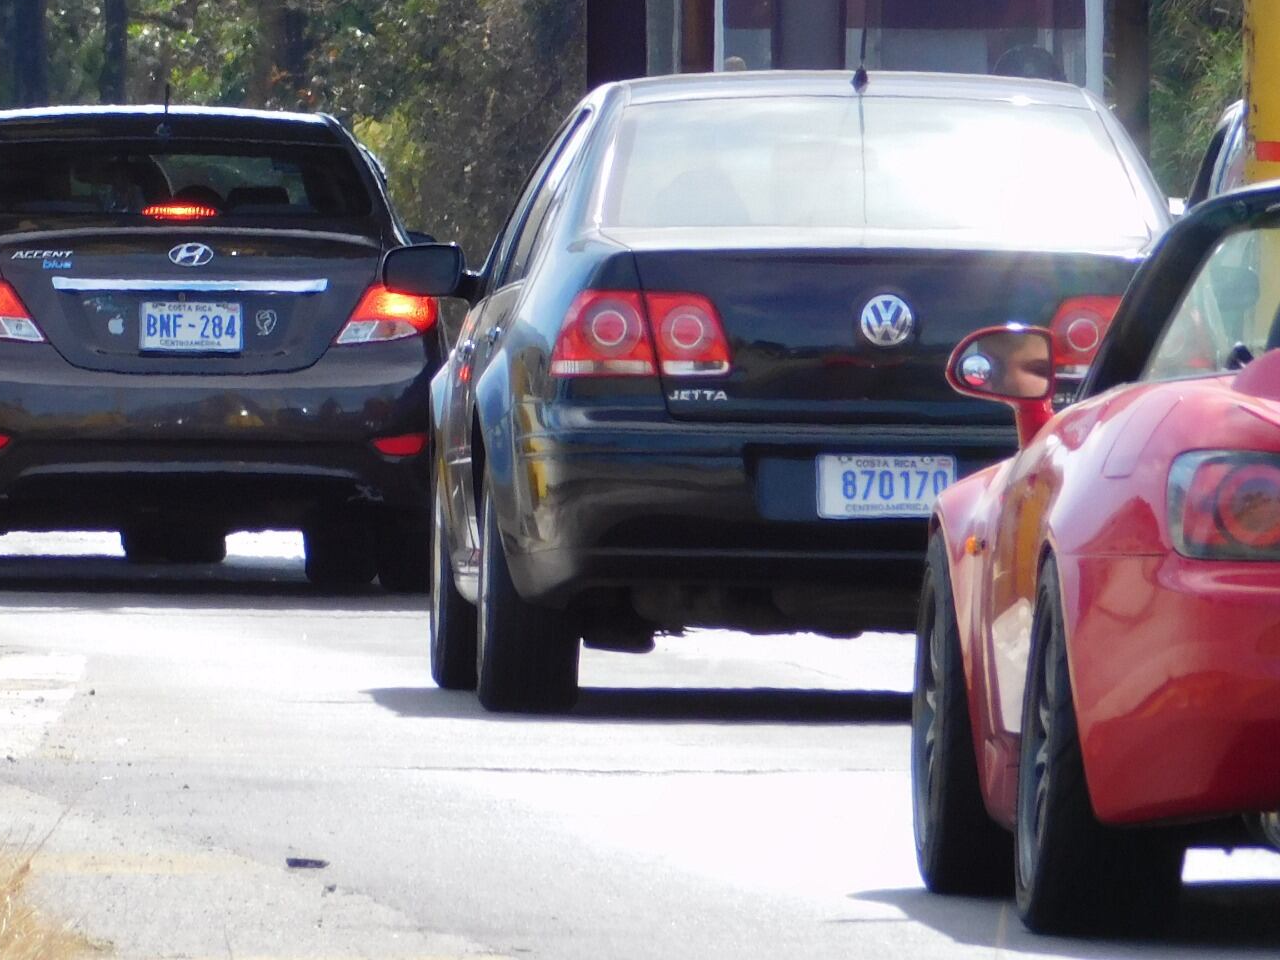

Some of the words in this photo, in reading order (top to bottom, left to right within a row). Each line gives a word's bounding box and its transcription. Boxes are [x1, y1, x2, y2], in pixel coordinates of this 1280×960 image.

[11, 250, 73, 259] ACCENT
[146, 314, 236, 338] BNF-284
[668, 390, 728, 400] JETTA
[856, 460, 889, 468] COSTA
[894, 459, 917, 468] RICA
[842, 470, 948, 499] 870170
[845, 503, 929, 512] CENTROAMERICA
